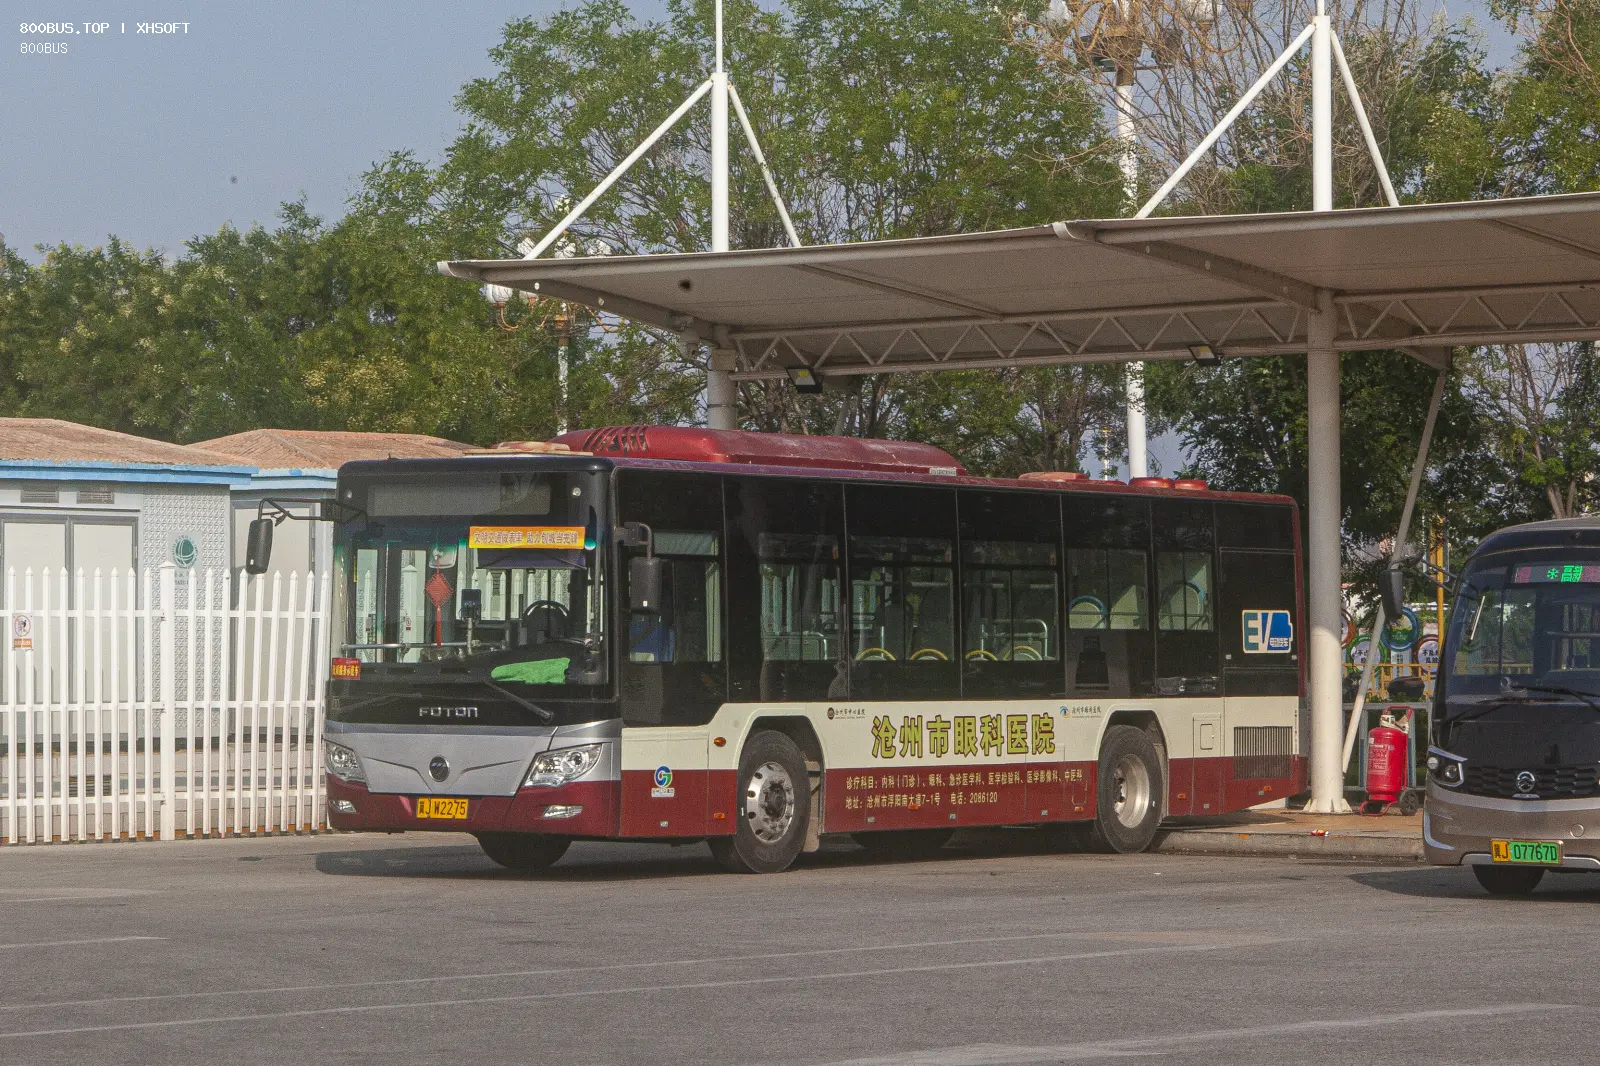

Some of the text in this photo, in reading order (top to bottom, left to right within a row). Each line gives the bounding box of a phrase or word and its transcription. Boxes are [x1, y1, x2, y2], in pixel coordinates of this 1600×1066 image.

[419, 706, 478, 718] FOTON
[871, 712, 1056, 758] 沧州市眼科医院
